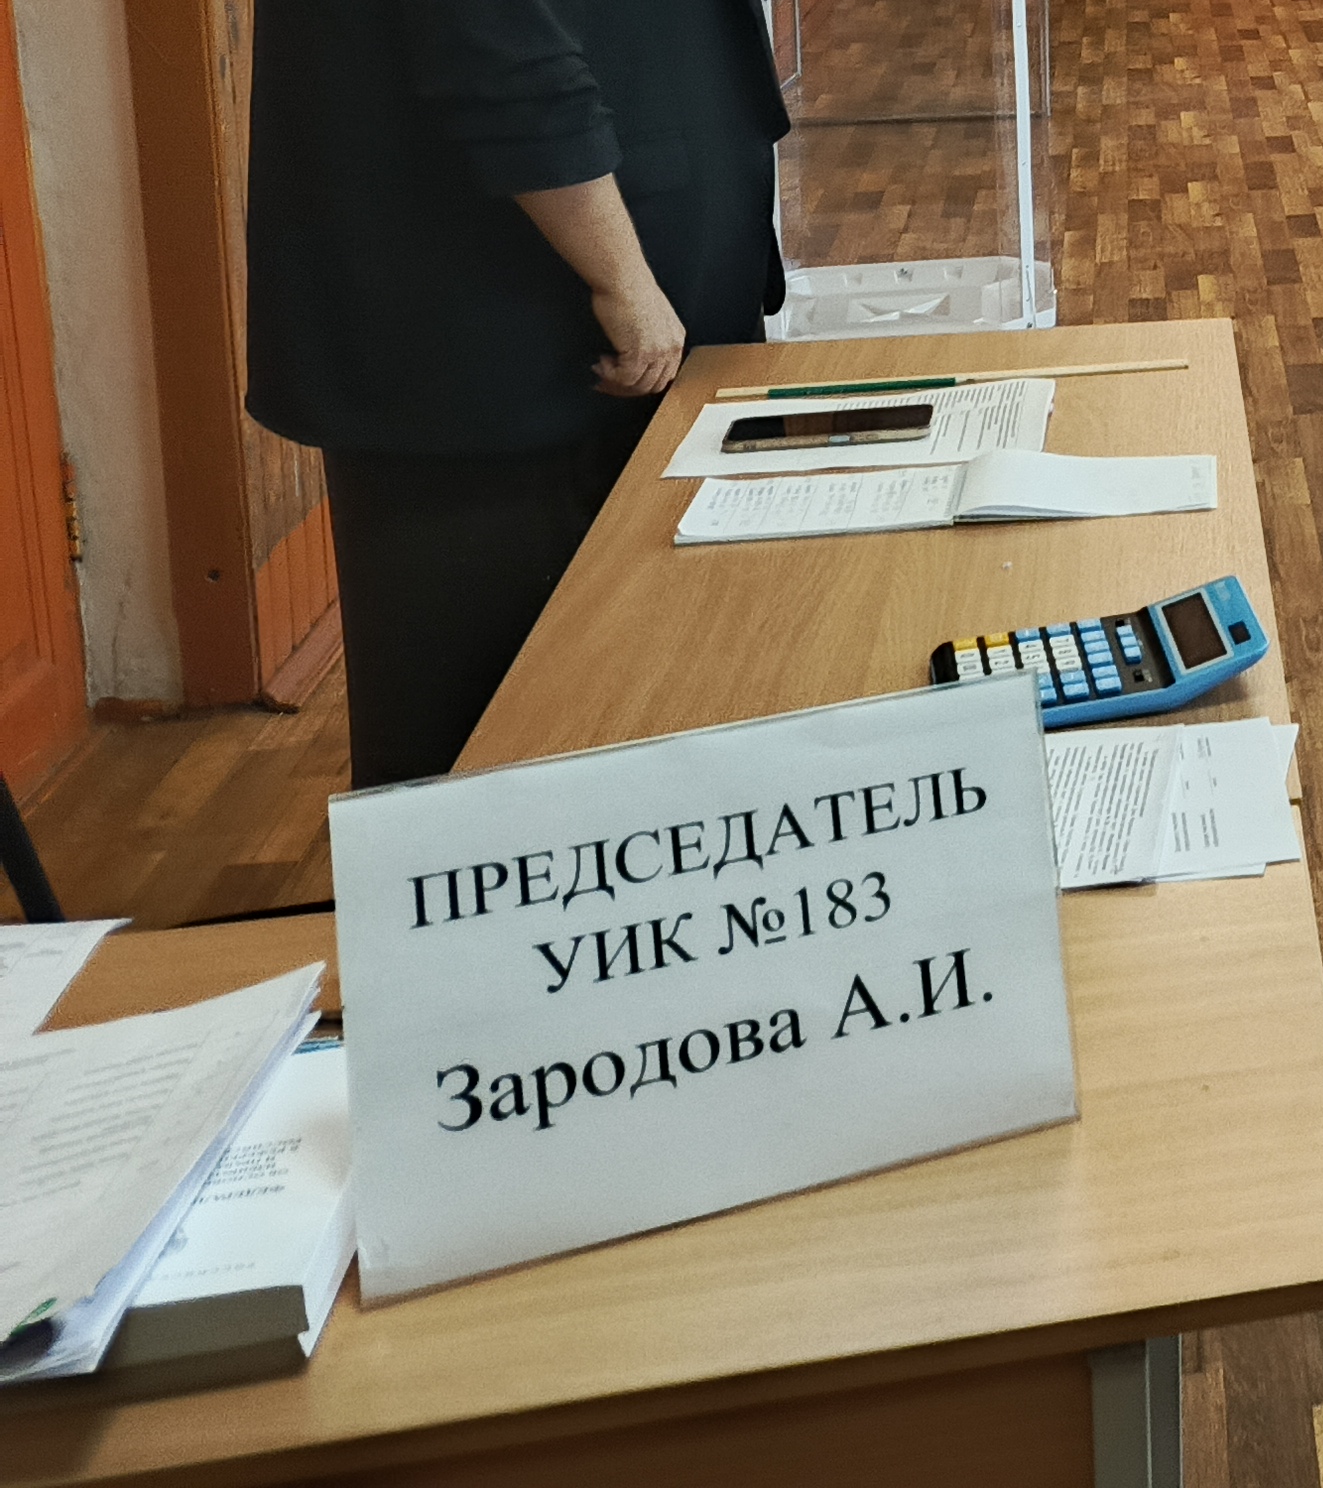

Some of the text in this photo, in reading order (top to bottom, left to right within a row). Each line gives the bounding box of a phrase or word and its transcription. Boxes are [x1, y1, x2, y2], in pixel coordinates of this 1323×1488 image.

[407, 766, 988, 929] ПРЕДСЕДАТЕЛЬ
[532, 870, 893, 994] УИК №183
[436, 948, 994, 1132] Зародова А.И.
